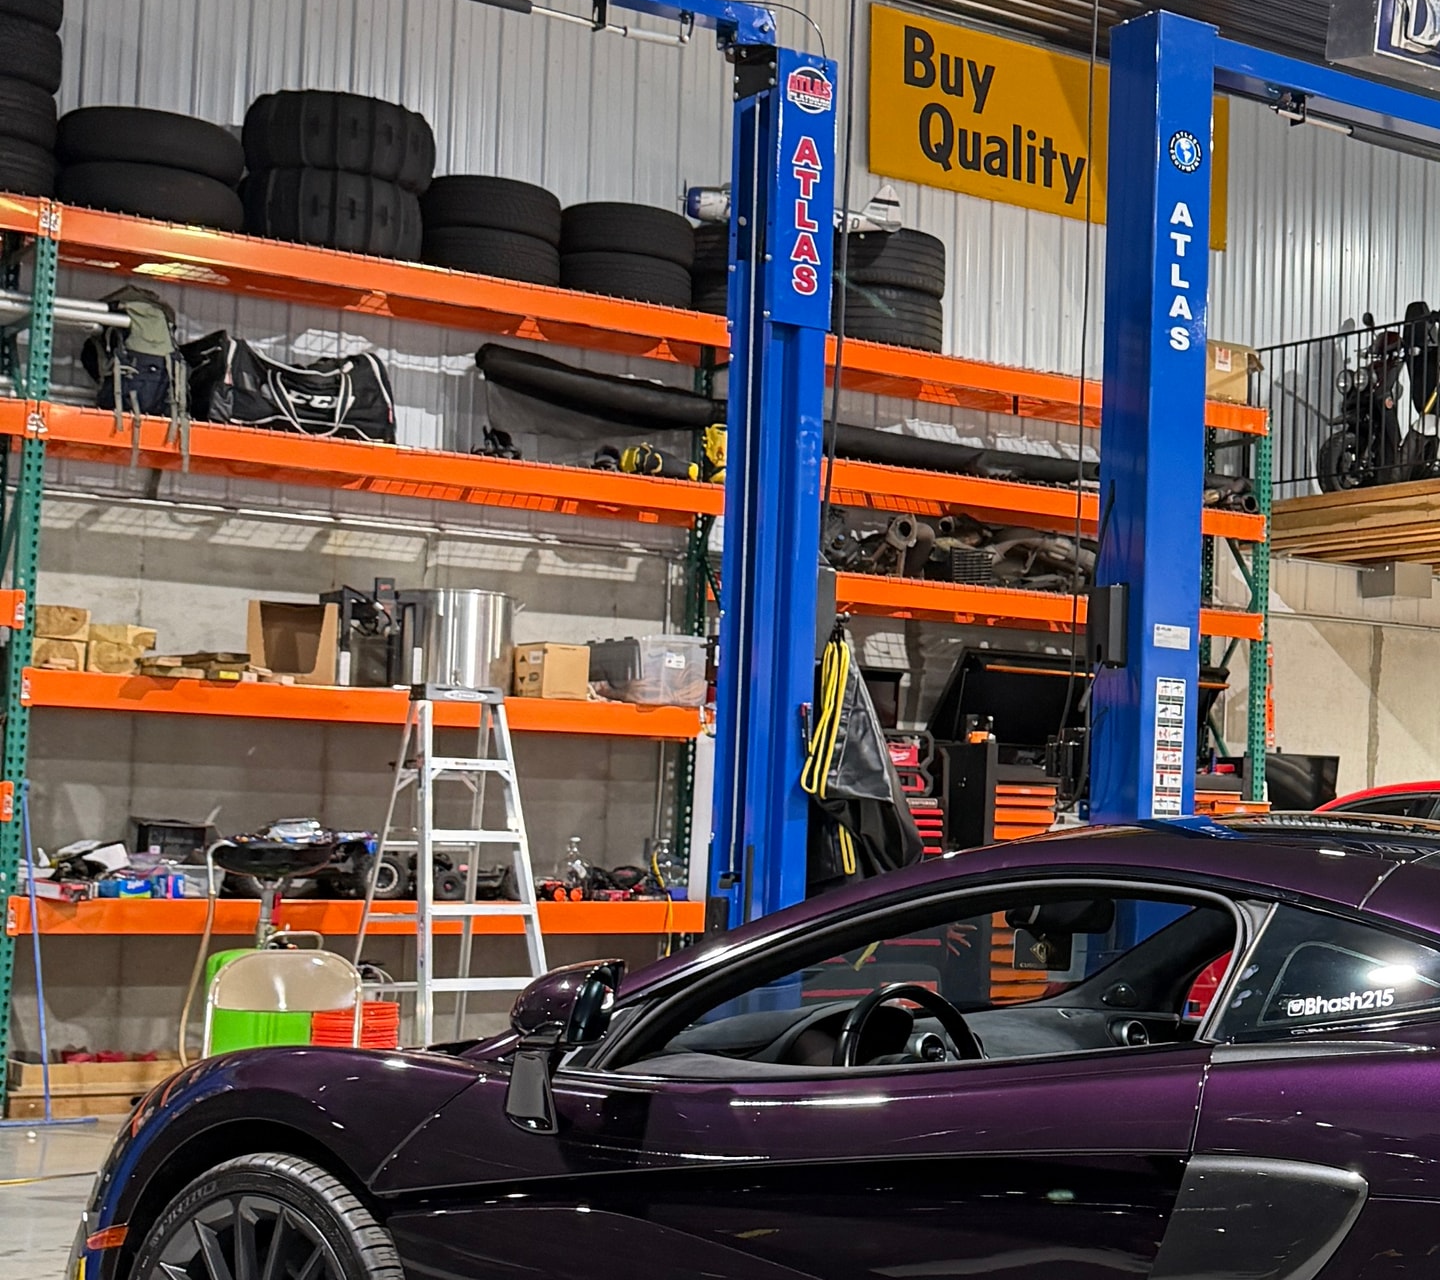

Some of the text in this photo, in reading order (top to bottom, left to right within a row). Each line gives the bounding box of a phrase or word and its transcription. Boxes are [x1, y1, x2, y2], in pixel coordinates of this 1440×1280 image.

[789, 74, 831, 100] ATLAS
[904, 24, 996, 115] Buy
[919, 102, 1087, 205] Quality
[791, 135, 823, 296] ATLAS
[1168, 201, 1194, 352] ATLAS
[1304, 988, 1395, 1016] Bhash215
